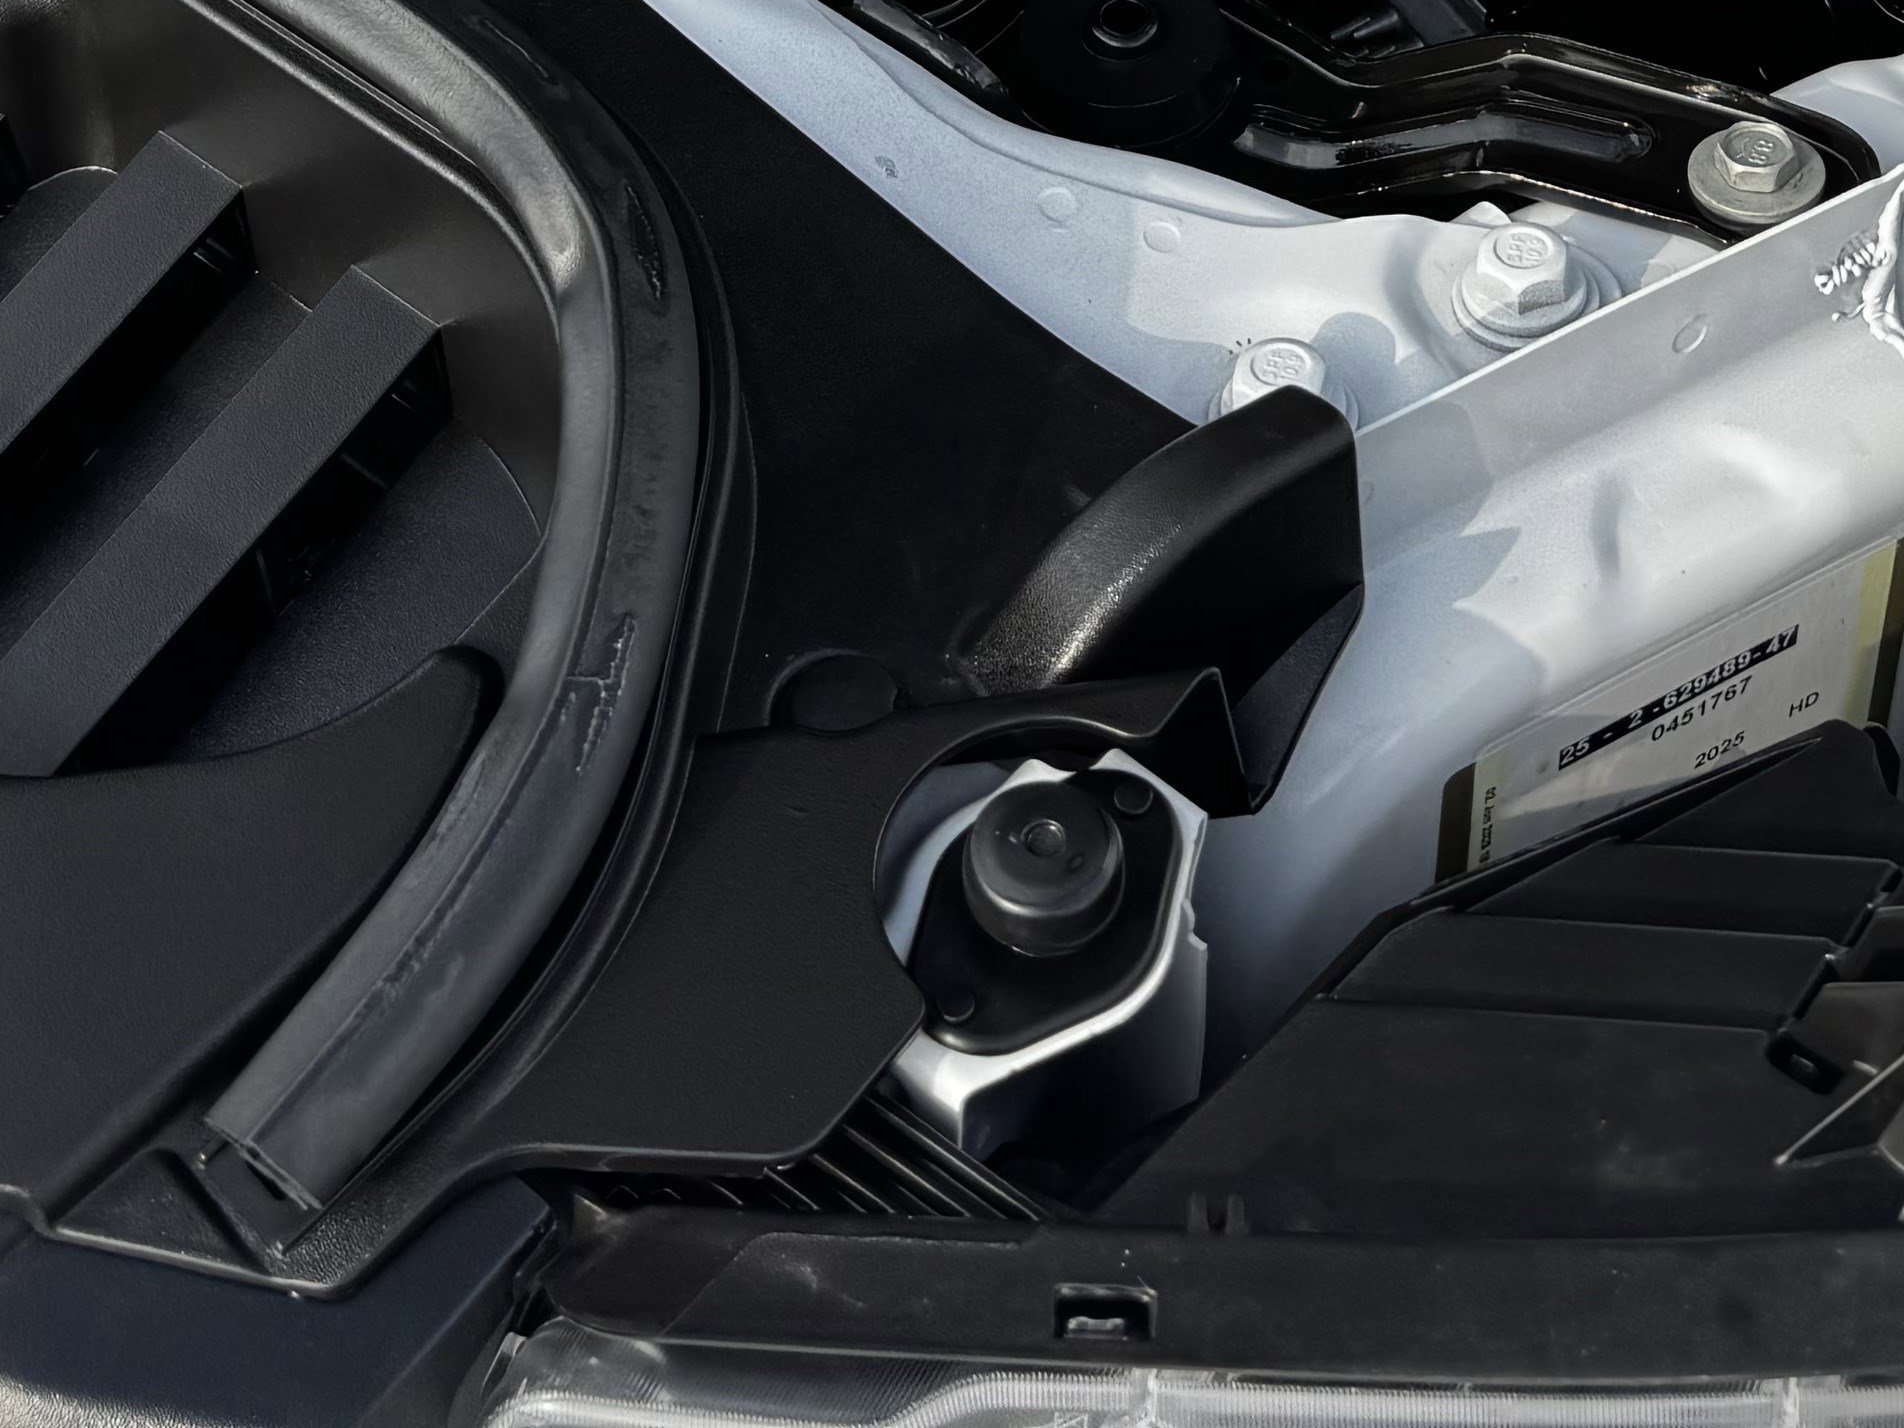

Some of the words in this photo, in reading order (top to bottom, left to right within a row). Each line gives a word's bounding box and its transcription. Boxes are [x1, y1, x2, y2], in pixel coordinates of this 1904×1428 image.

[1651, 675, 1753, 742] 0451767
[1788, 690, 1821, 718] HD
[1560, 737, 1590, 765] 25
[1694, 730, 1746, 769] 2025
